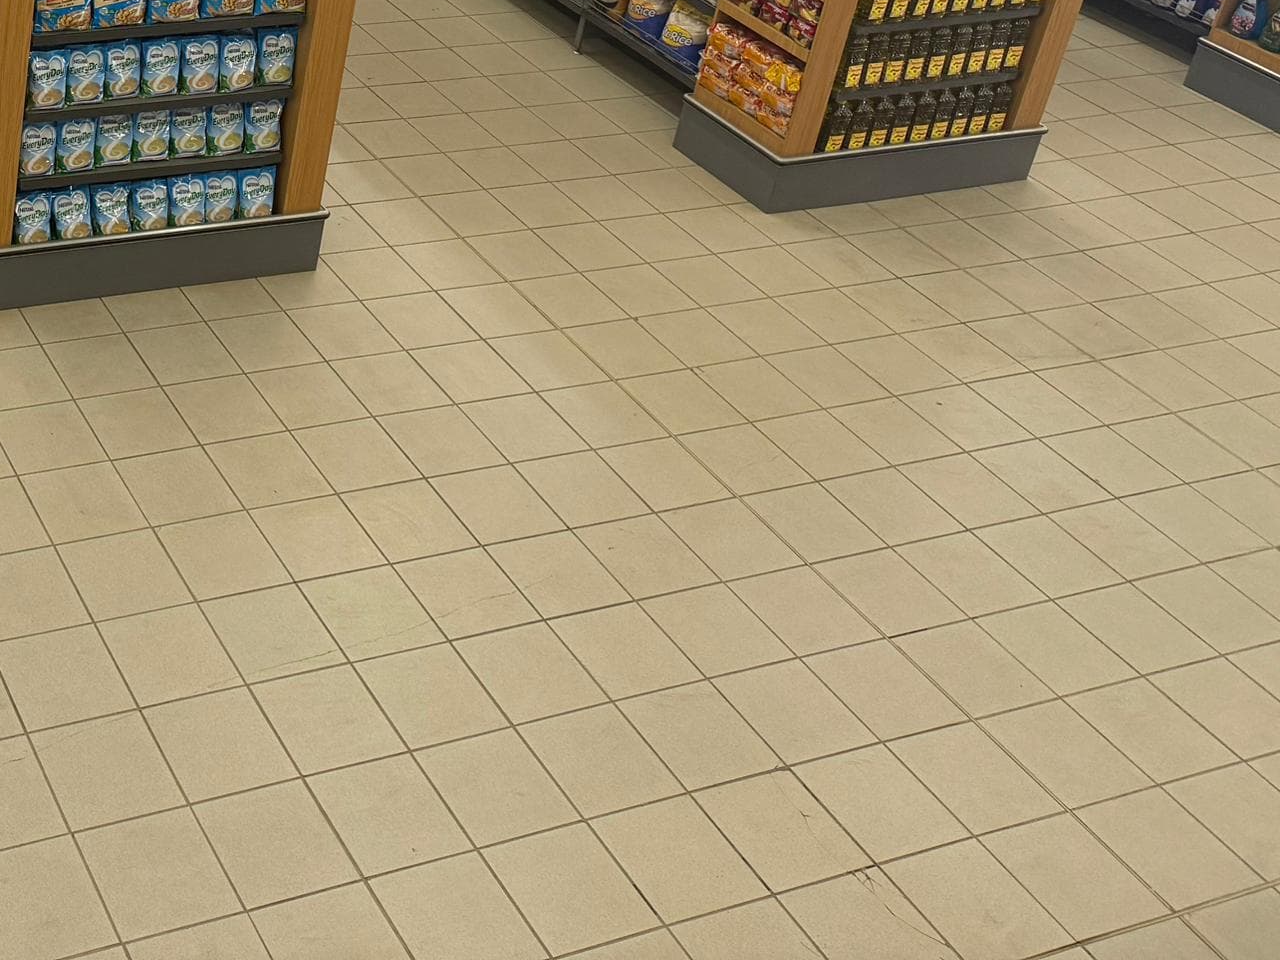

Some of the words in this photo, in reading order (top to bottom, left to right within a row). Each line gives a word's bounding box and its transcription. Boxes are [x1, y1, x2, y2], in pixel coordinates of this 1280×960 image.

[635, 5, 656, 18] Rice
[671, 31, 693, 46] Rice
[262, 43, 294, 58] EveryDay
[186, 52, 217, 66] EveryDay
[32, 68, 64, 82] EveryDay
[22, 136, 55, 150] EveryDay
